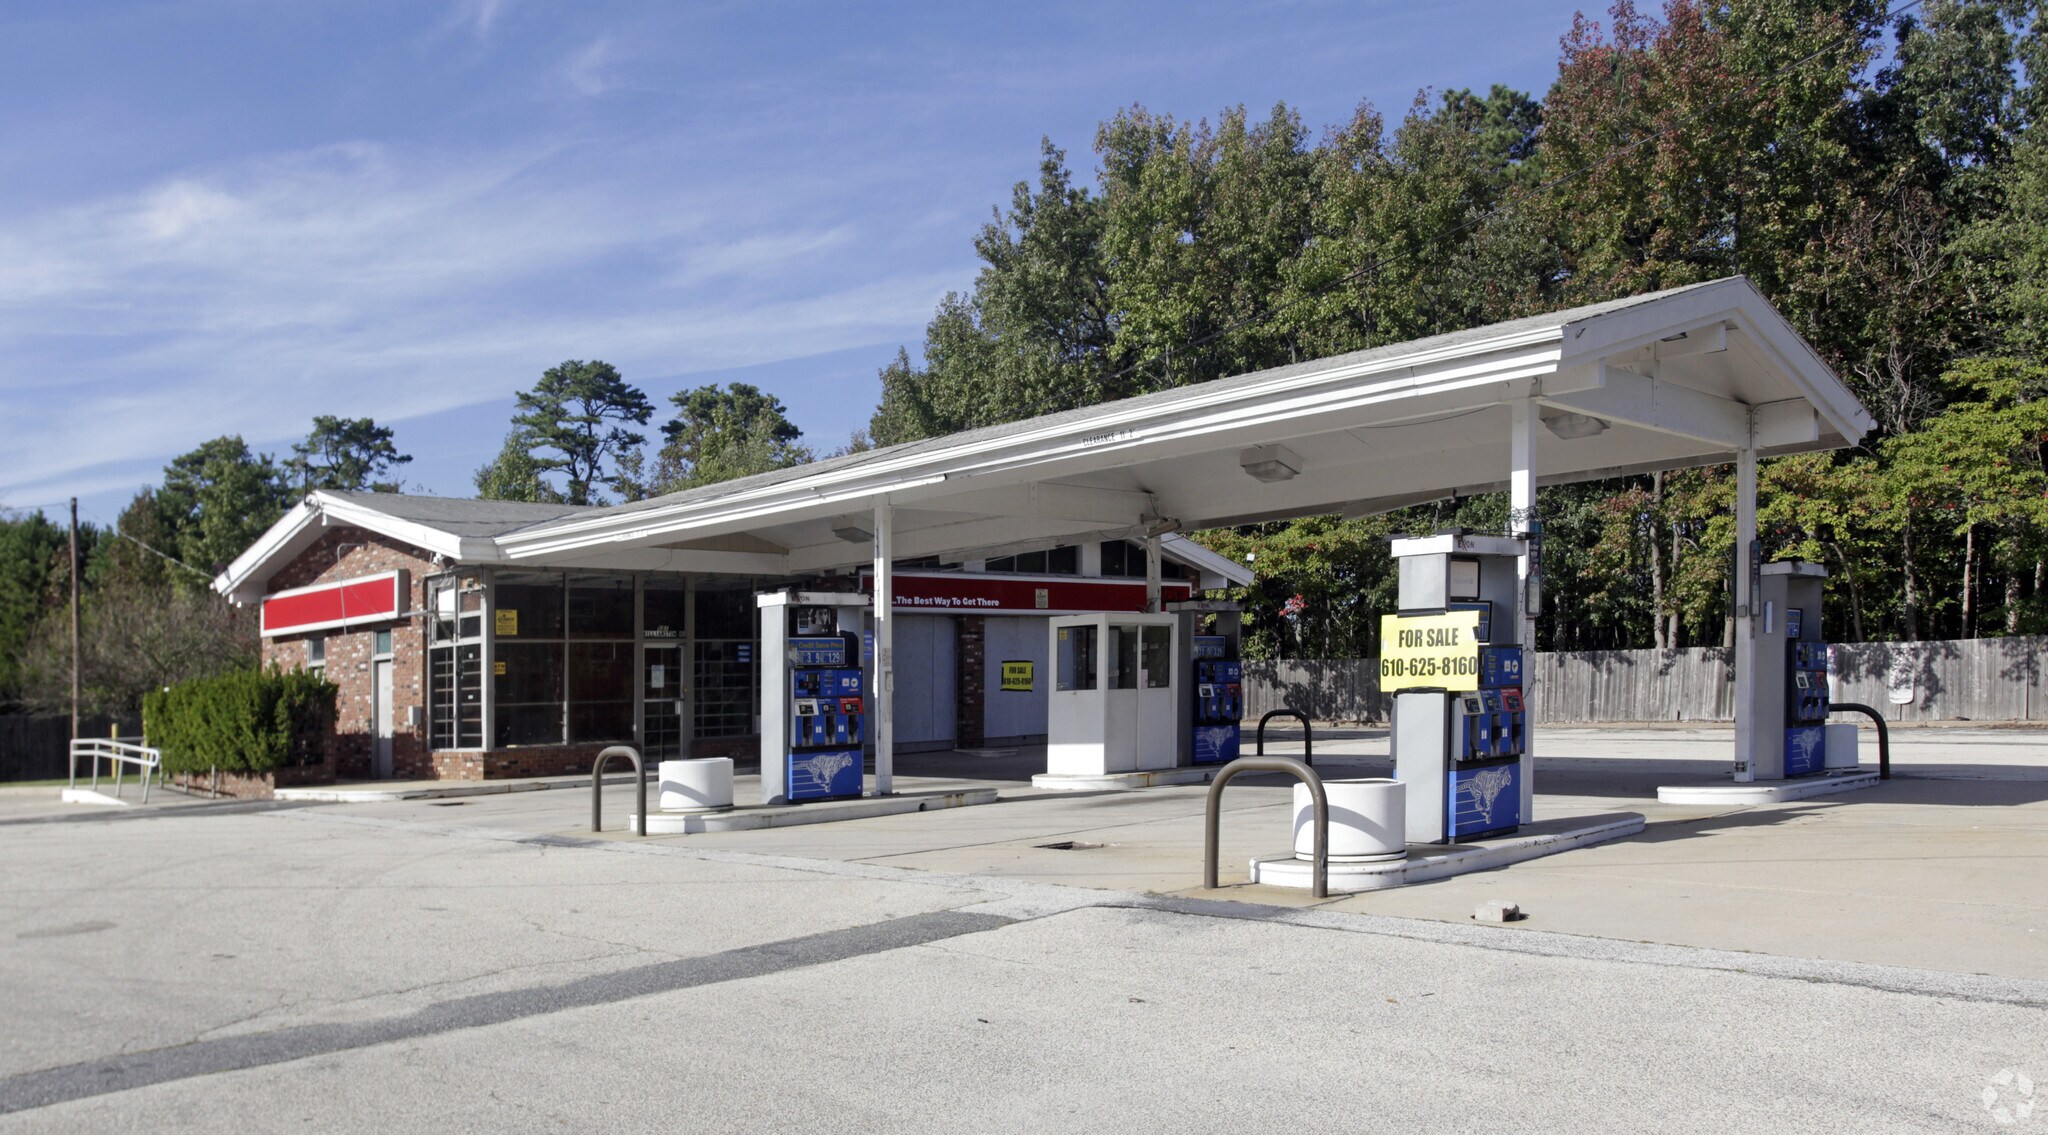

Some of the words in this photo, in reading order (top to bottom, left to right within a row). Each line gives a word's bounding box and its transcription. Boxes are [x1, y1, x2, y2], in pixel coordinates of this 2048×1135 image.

[1082, 432, 1116, 447] CLEARANCE
[913, 596, 933, 605] Best
[934, 597, 951, 607] Way
[952, 597, 961, 605] To
[962, 597, 976, 606] Get
[977, 597, 1000, 606] There
[1399, 628, 1423, 648] FOR
[1426, 627, 1459, 648] SALE
[1381, 656, 1478, 677] 610-625-8160
